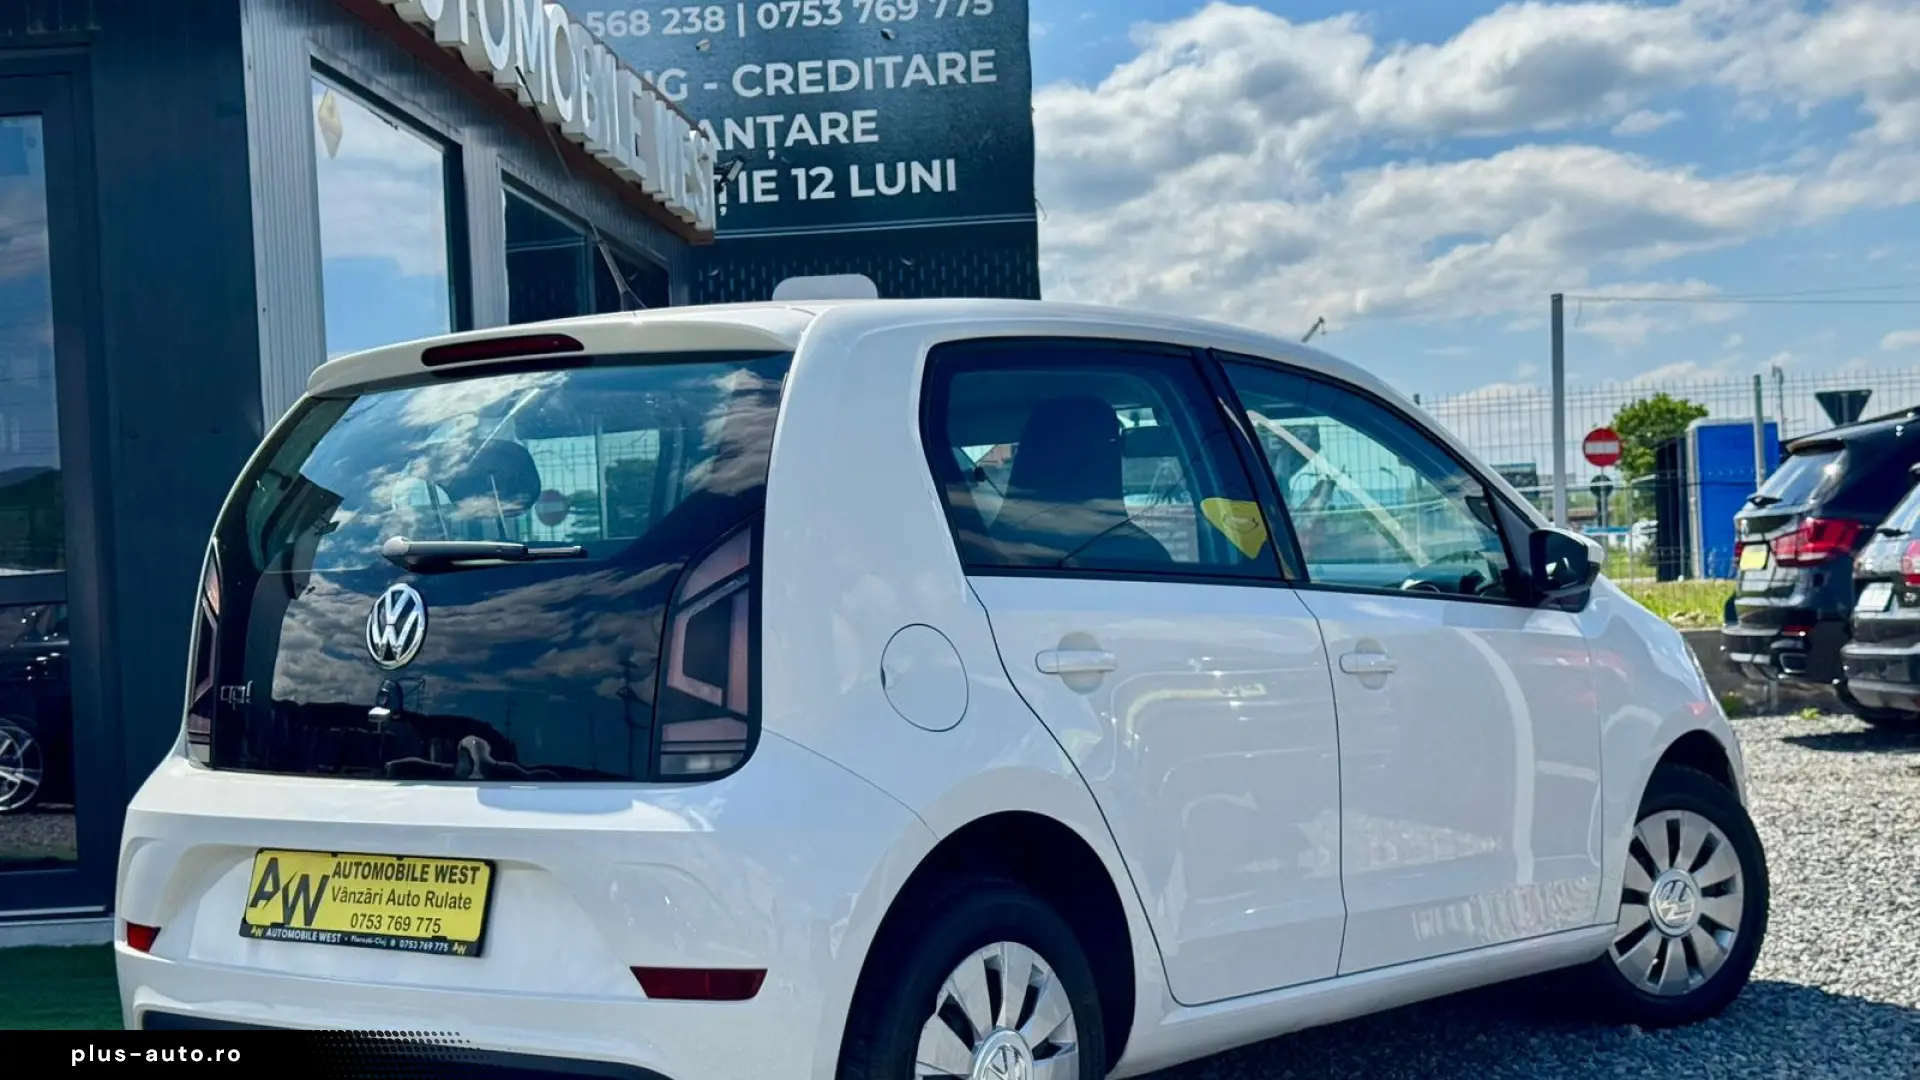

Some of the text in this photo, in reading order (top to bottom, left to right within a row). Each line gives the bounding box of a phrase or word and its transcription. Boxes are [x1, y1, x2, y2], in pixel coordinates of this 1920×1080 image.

[587, 9, 651, 38] 568
[661, 5, 726, 35] 238
[756, 0, 843, 30] 0753
[853, 0, 919, 24] 769
[732, 49, 997, 98] CREDITARE
[791, 166, 836, 201] 12
[849, 158, 957, 198] LUNI
[366, 582, 430, 671] VW
[332, 861, 481, 885] AUTOMOBILE WEST
[386, 888, 421, 908] Auto
[423, 890, 472, 910] Rulate
[350, 912, 442, 934] 0753 769 775
[266, 927, 317, 941] AUTOMOBILE
[319, 931, 342, 943] WEST
[400, 939, 418, 950] 0753
[419, 940, 433, 951] 769
[433, 942, 449, 952] 775
